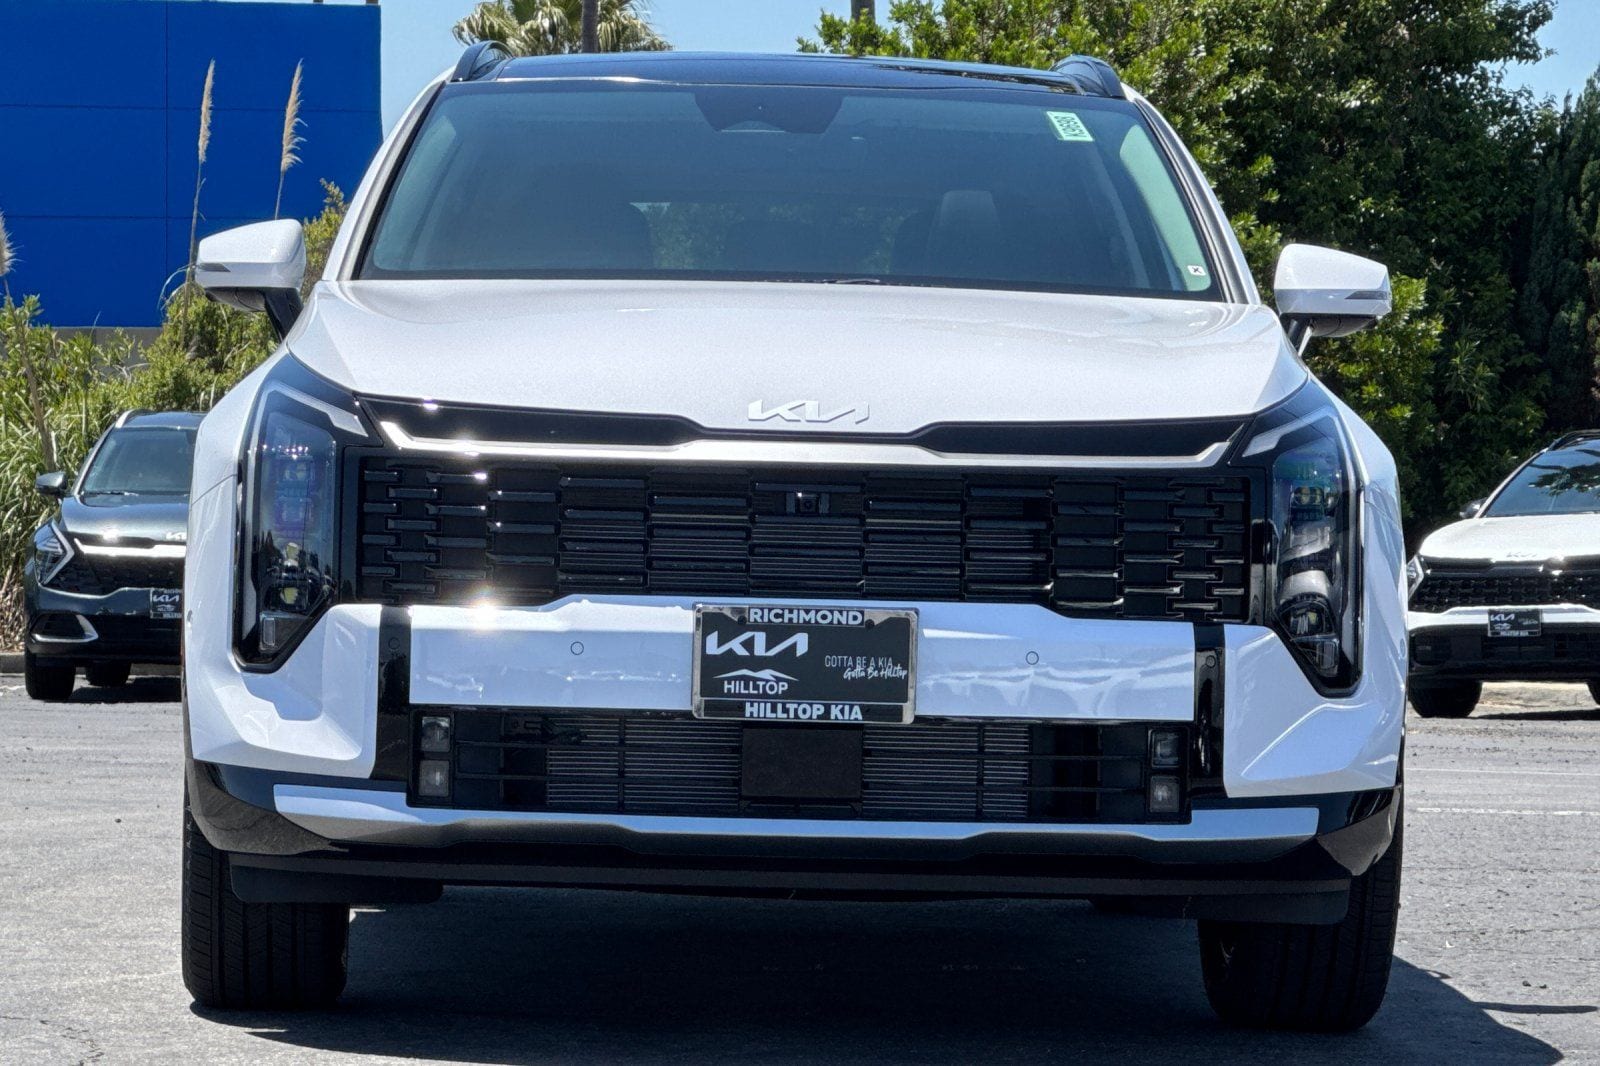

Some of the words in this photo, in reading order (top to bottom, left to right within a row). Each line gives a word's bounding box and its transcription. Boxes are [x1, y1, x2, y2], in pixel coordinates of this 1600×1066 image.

[748, 399, 870, 424] KIA
[153, 594, 180, 602] KIA
[749, 608, 863, 625] RICHMOND
[1490, 613, 1515, 621] KIA
[705, 630, 809, 657] KIA
[824, 655, 853, 667] GOTTA
[856, 656, 867, 668] BE
[869, 657, 875, 668] A
[878, 657, 893, 668] KIA
[843, 666, 865, 680] Gotta
[867, 666, 879, 679] Be
[880, 664, 908, 679] Hilltop
[723, 680, 789, 695] HILLTOP
[745, 702, 825, 719] HILLTOP
[830, 704, 863, 721] KIA
